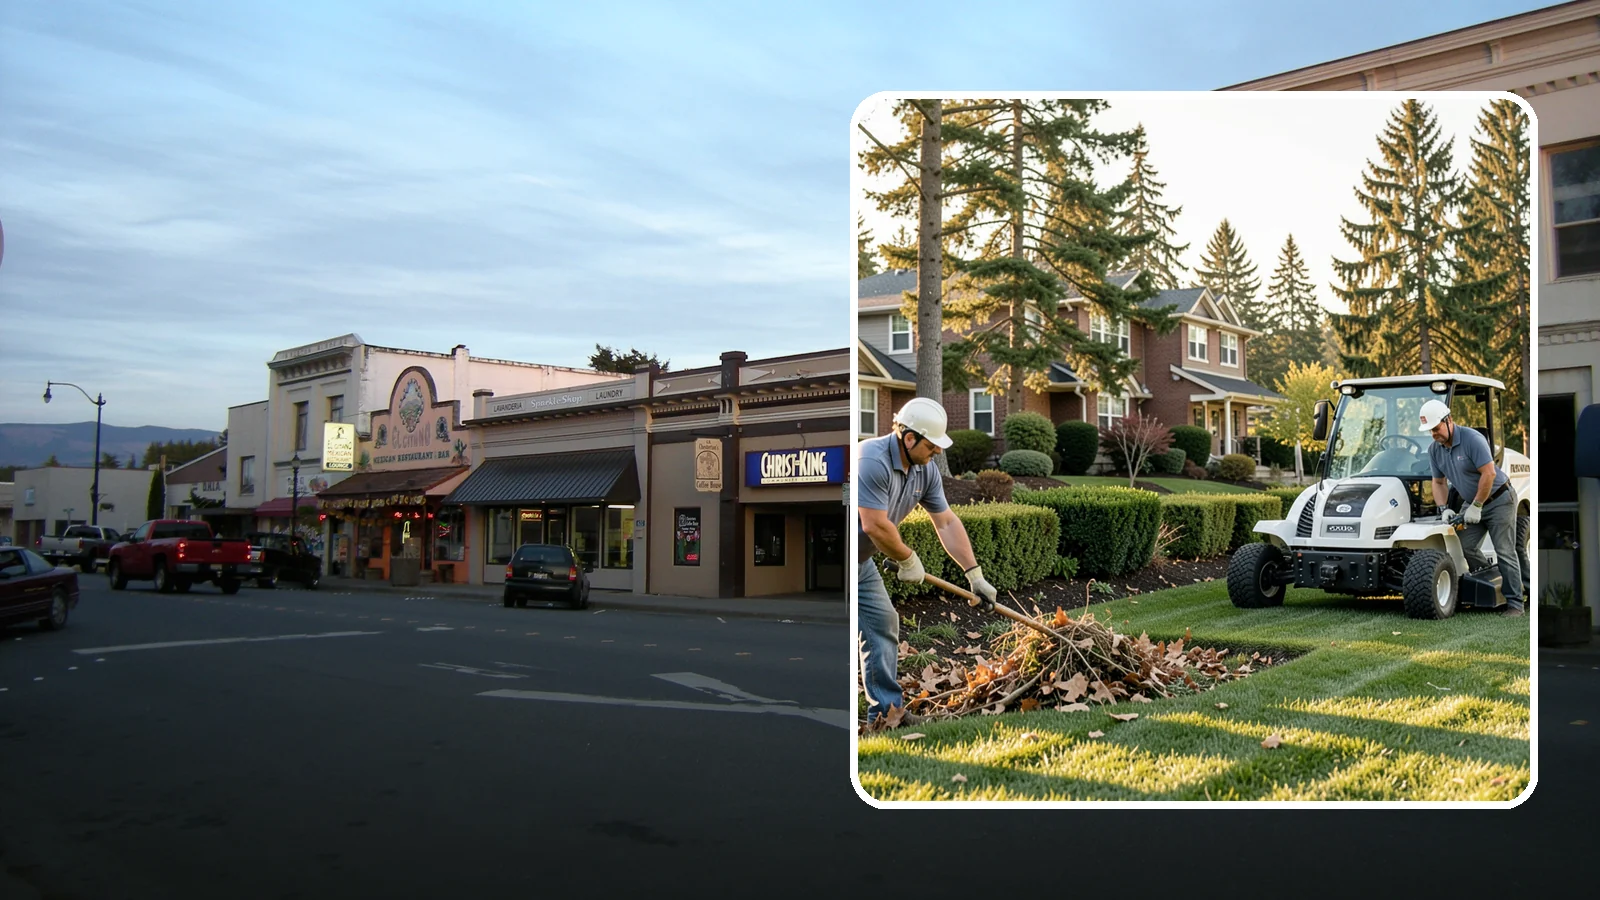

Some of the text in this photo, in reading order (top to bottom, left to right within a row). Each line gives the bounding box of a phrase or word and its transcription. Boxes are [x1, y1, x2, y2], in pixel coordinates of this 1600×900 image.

[531, 394, 582, 409] Sparkle Shop
[596, 389, 623, 400] LAUNDRY
[494, 402, 522, 412] LAVANDERIA
[374, 455, 395, 466] MEXICAN
[397, 451, 433, 463] RESTAURANT
[438, 450, 450, 459] BAR
[799, 450, 827, 476] KING
